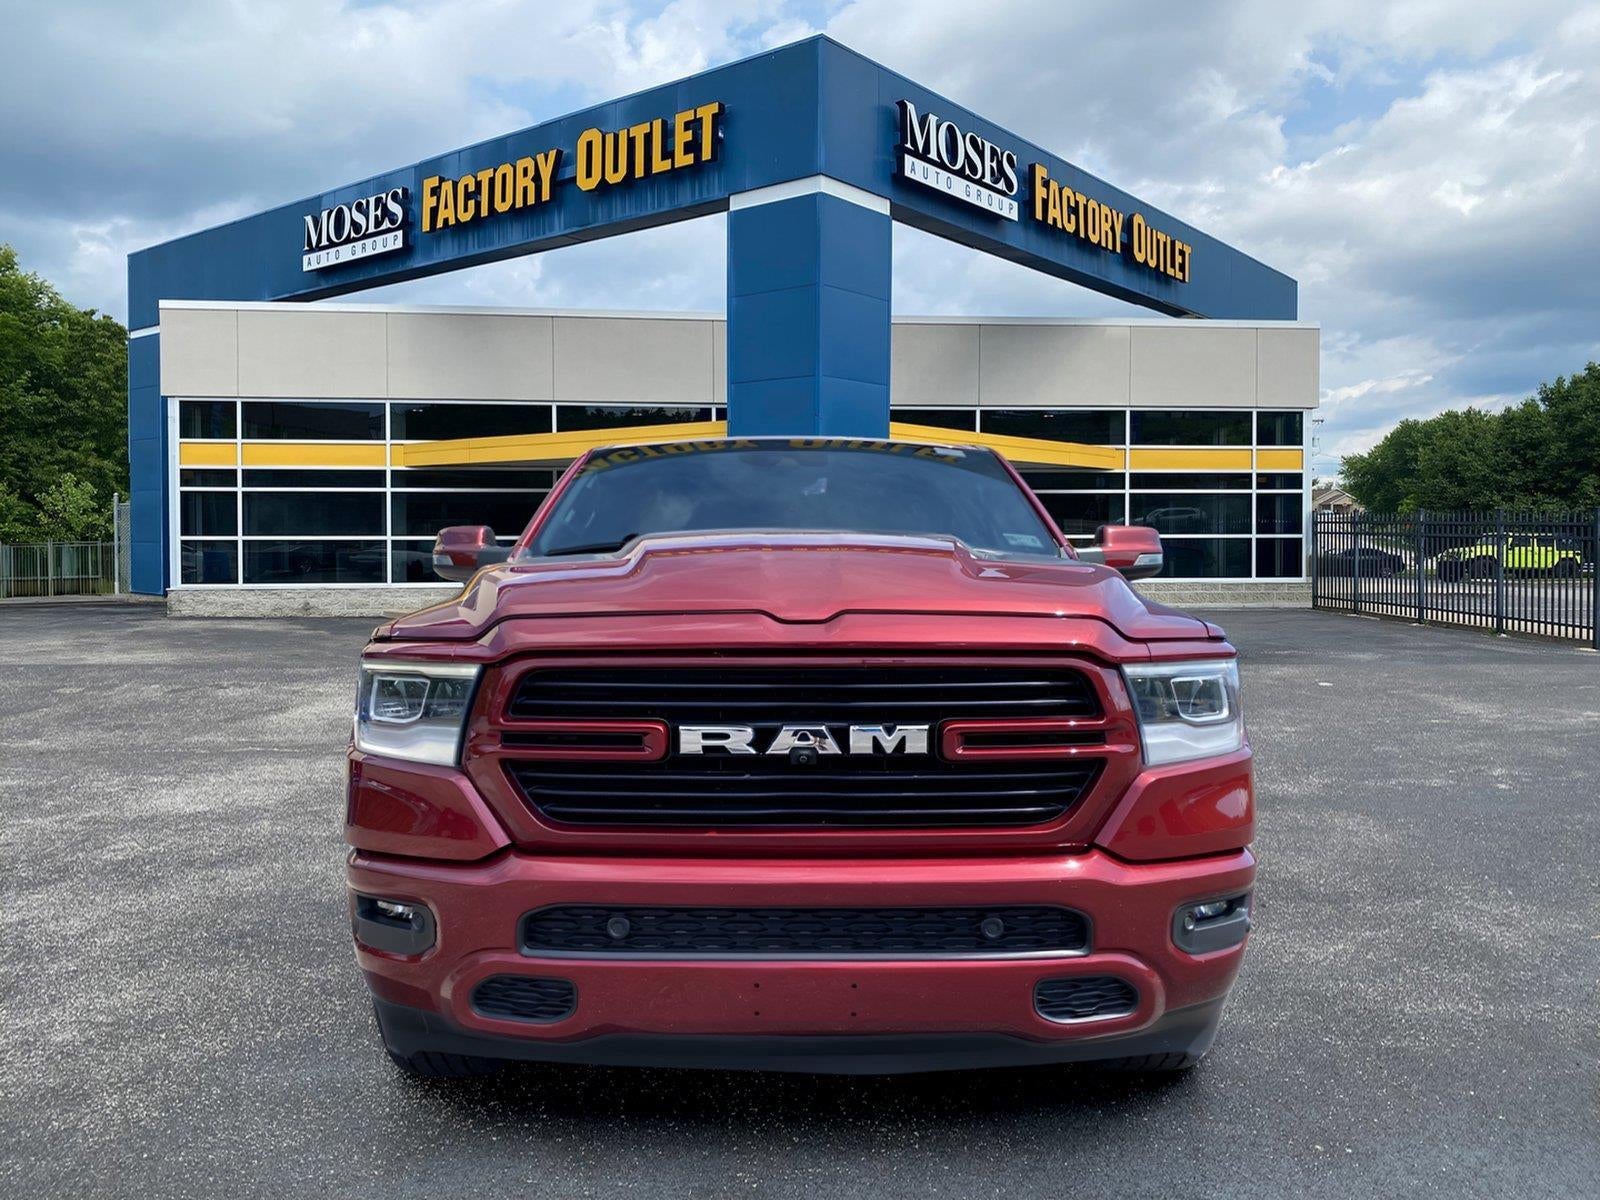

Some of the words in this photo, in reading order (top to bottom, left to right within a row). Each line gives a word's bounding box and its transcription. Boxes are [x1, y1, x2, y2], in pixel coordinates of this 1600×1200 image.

[421, 149, 557, 232] FACTORY
[576, 102, 719, 191] OUTLET
[904, 99, 1019, 196] MOSES
[303, 187, 404, 251] MOSES
[910, 161, 953, 190] AUTO
[964, 184, 1014, 214] GROUP
[307, 249, 340, 267] AUTO
[351, 234, 399, 256] GROUP
[1034, 163, 1123, 253] FACTORY
[1132, 213, 1192, 283] OUTLET
[679, 725, 930, 755] RAM
